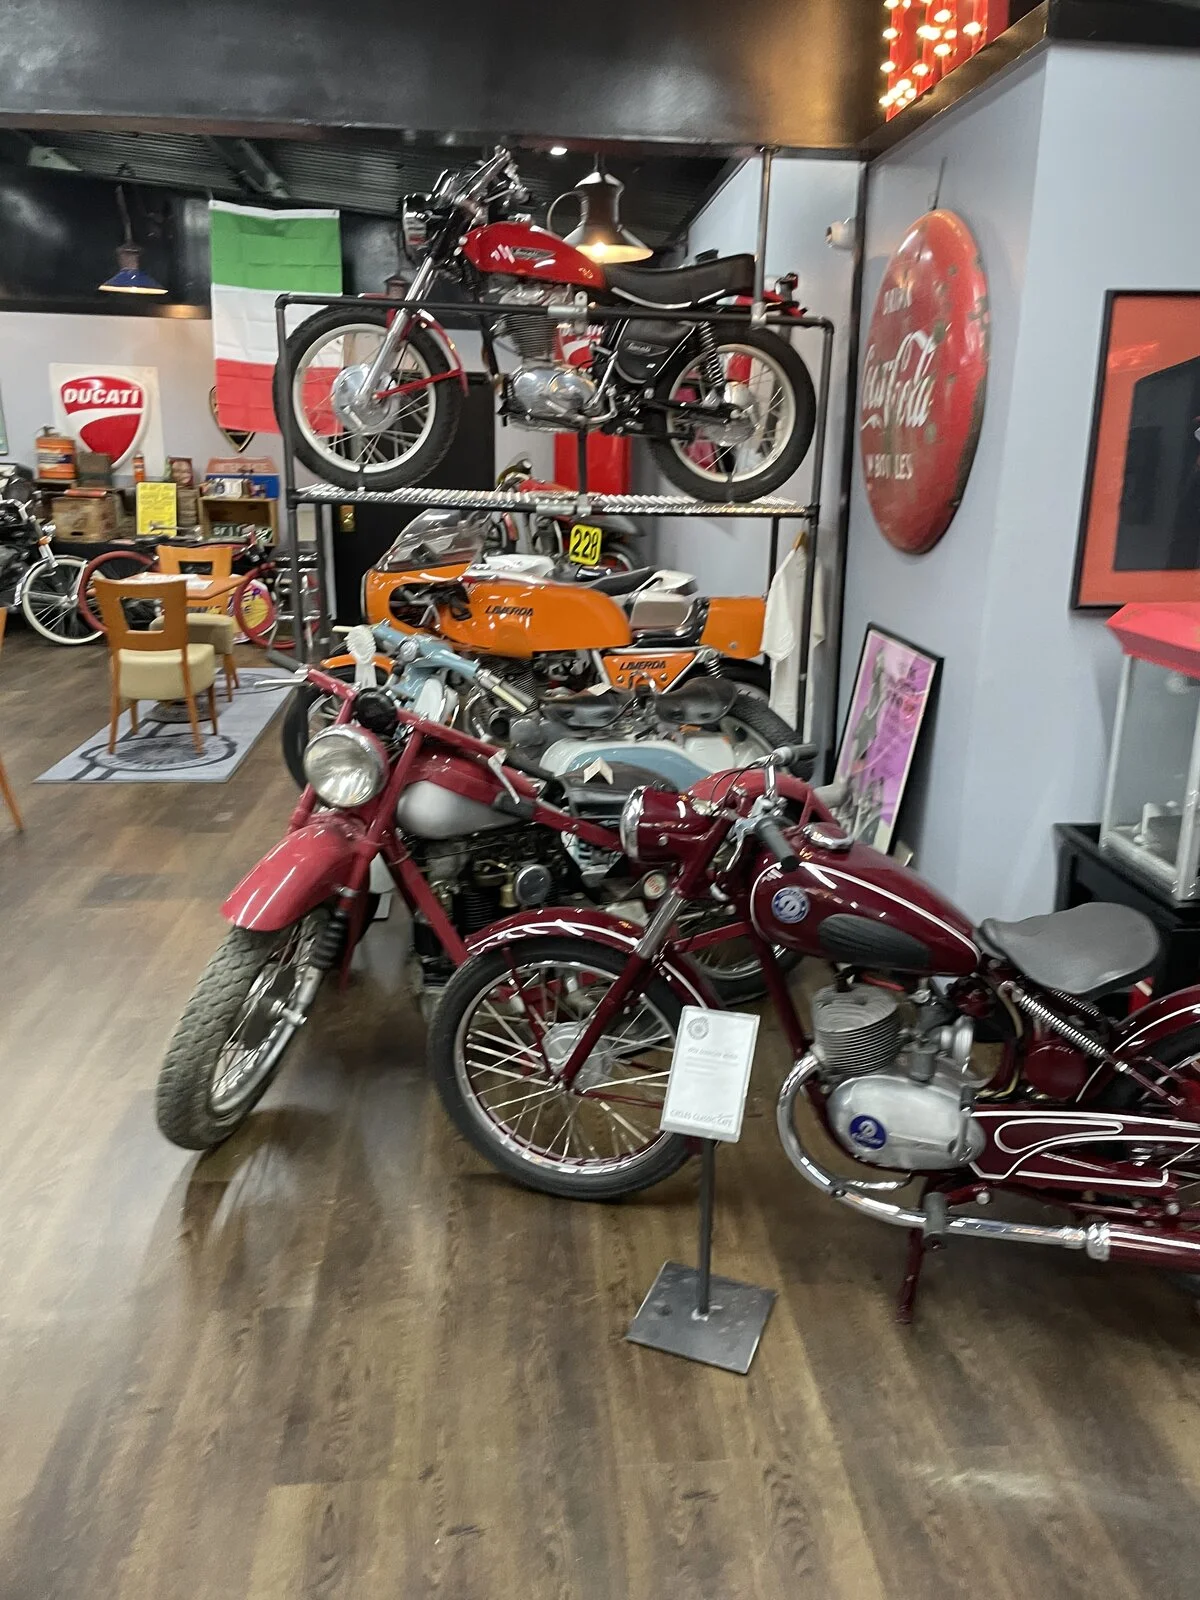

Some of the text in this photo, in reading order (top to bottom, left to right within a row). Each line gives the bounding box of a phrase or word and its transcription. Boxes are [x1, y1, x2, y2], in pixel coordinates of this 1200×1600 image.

[63, 388, 139, 405] DUCATI
[875, 453, 913, 480] BOLES
[571, 528, 599, 560] 228
[619, 660, 666, 671] LAVERDA
